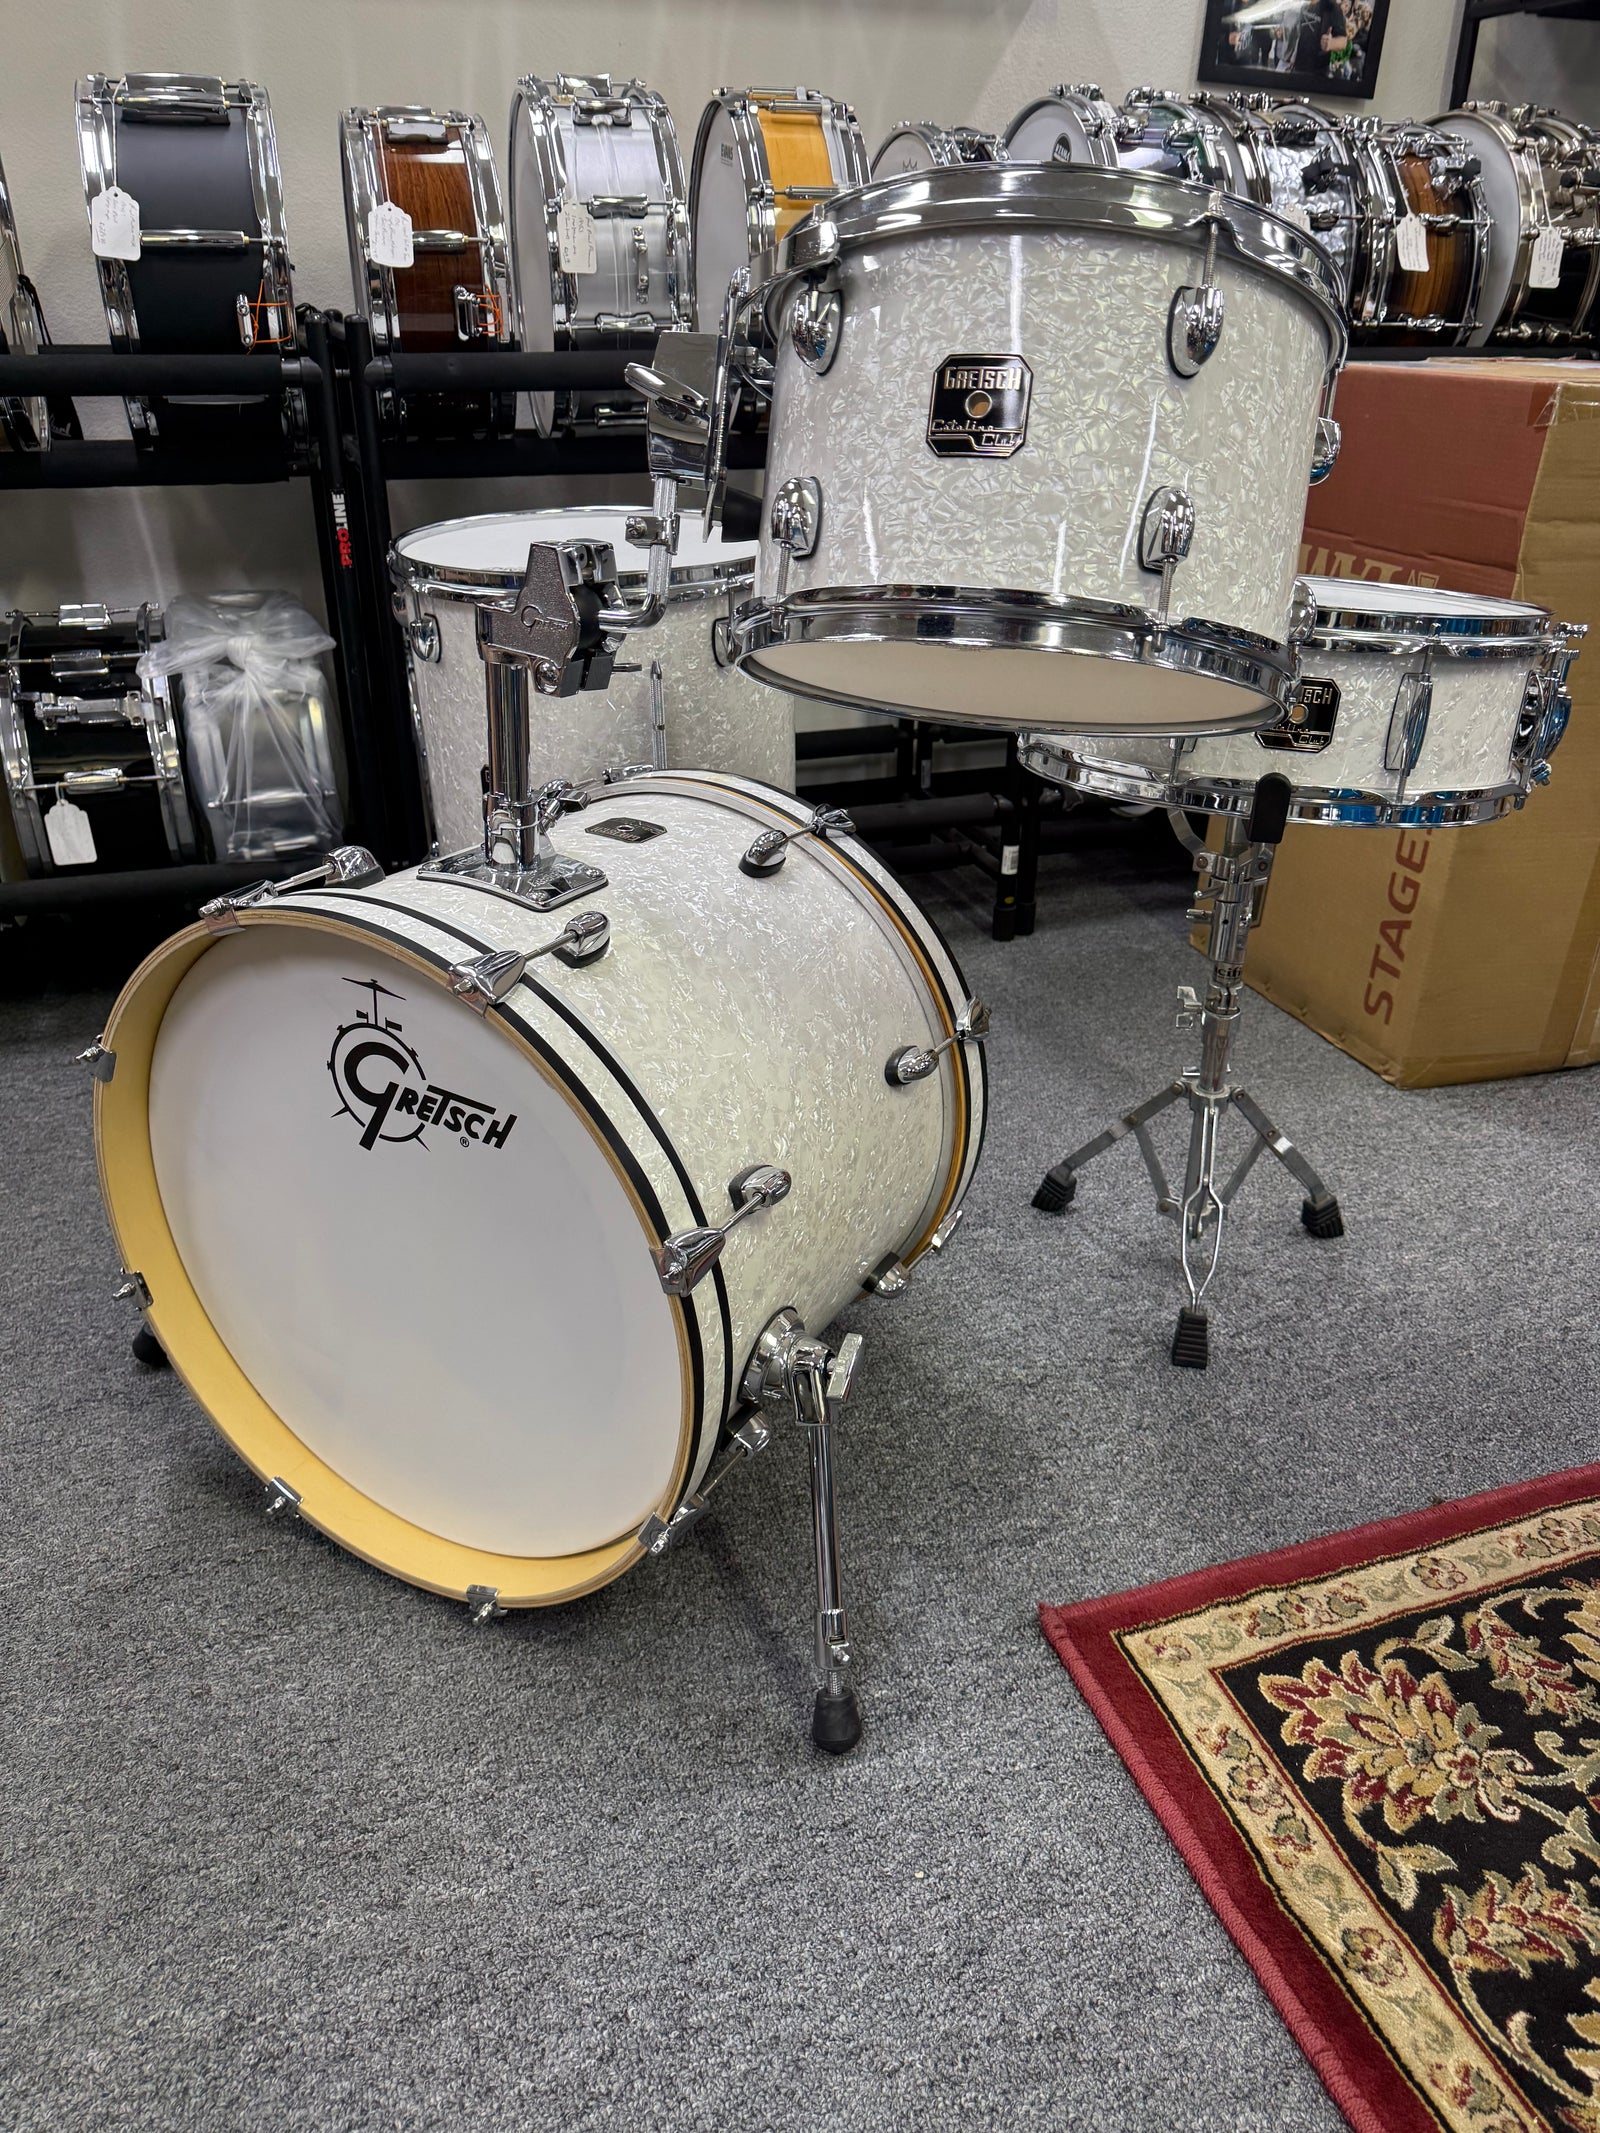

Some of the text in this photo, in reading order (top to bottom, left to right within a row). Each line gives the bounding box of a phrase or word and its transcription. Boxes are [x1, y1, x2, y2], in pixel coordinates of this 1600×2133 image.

[943, 366, 1023, 391] GRETSCH
[931, 418, 996, 433] Catalina
[981, 432, 1017, 447] Club
[1363, 828, 1433, 1026] STAGE
[343, 1040, 518, 1151] GRETSCH
